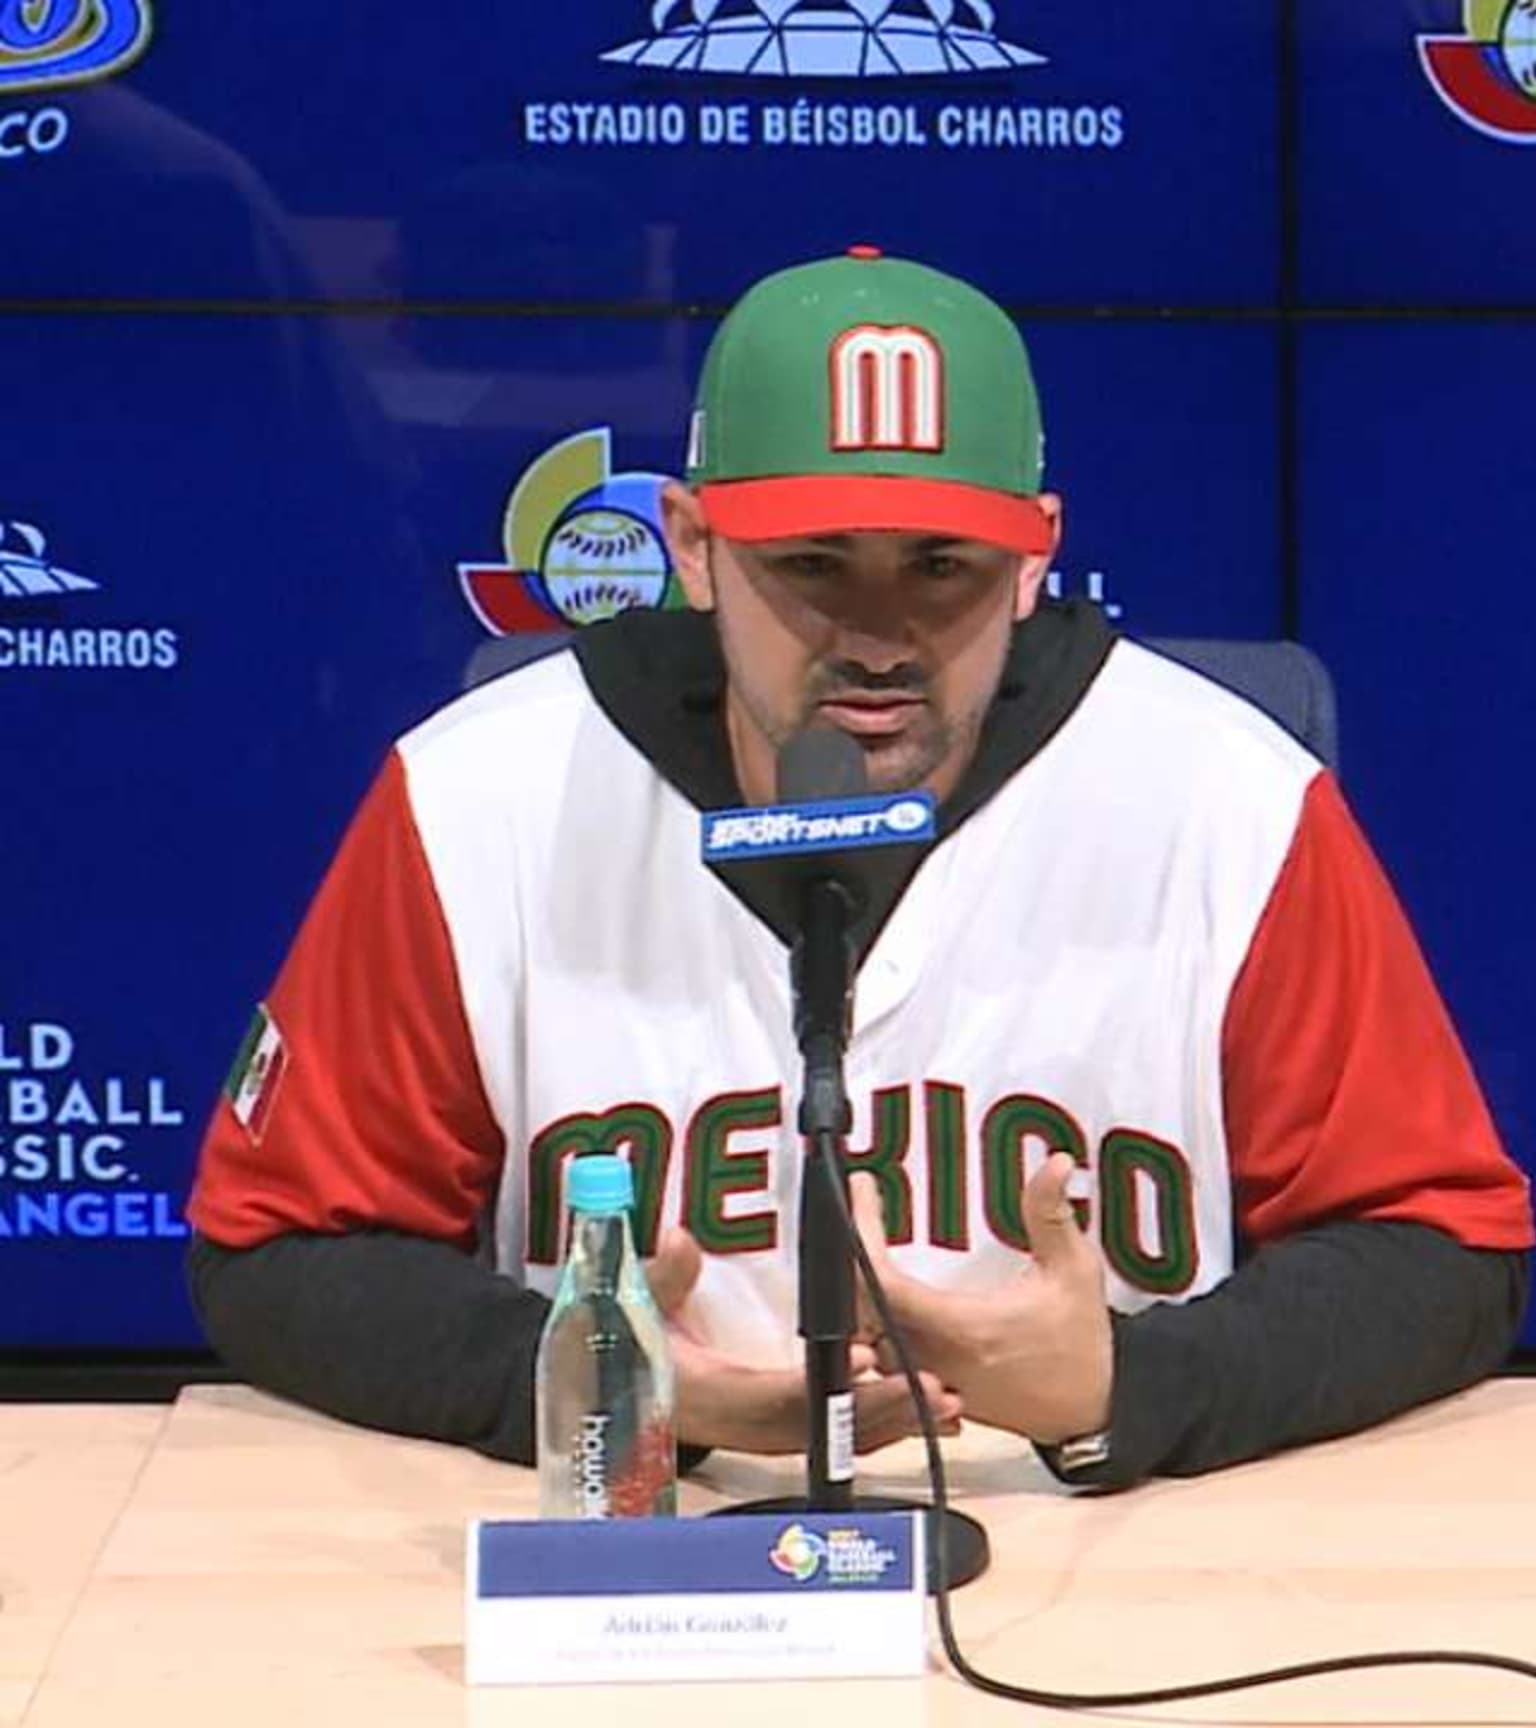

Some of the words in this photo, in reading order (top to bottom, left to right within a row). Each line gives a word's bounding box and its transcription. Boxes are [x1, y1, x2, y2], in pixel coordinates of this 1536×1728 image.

[524, 102, 686, 145] ESTADIO
[700, 103, 750, 144] DE
[762, 97, 927, 146] BÉISBOL
[937, 105, 1124, 147] CHARROS
[9, 1078, 183, 1125] BALL
